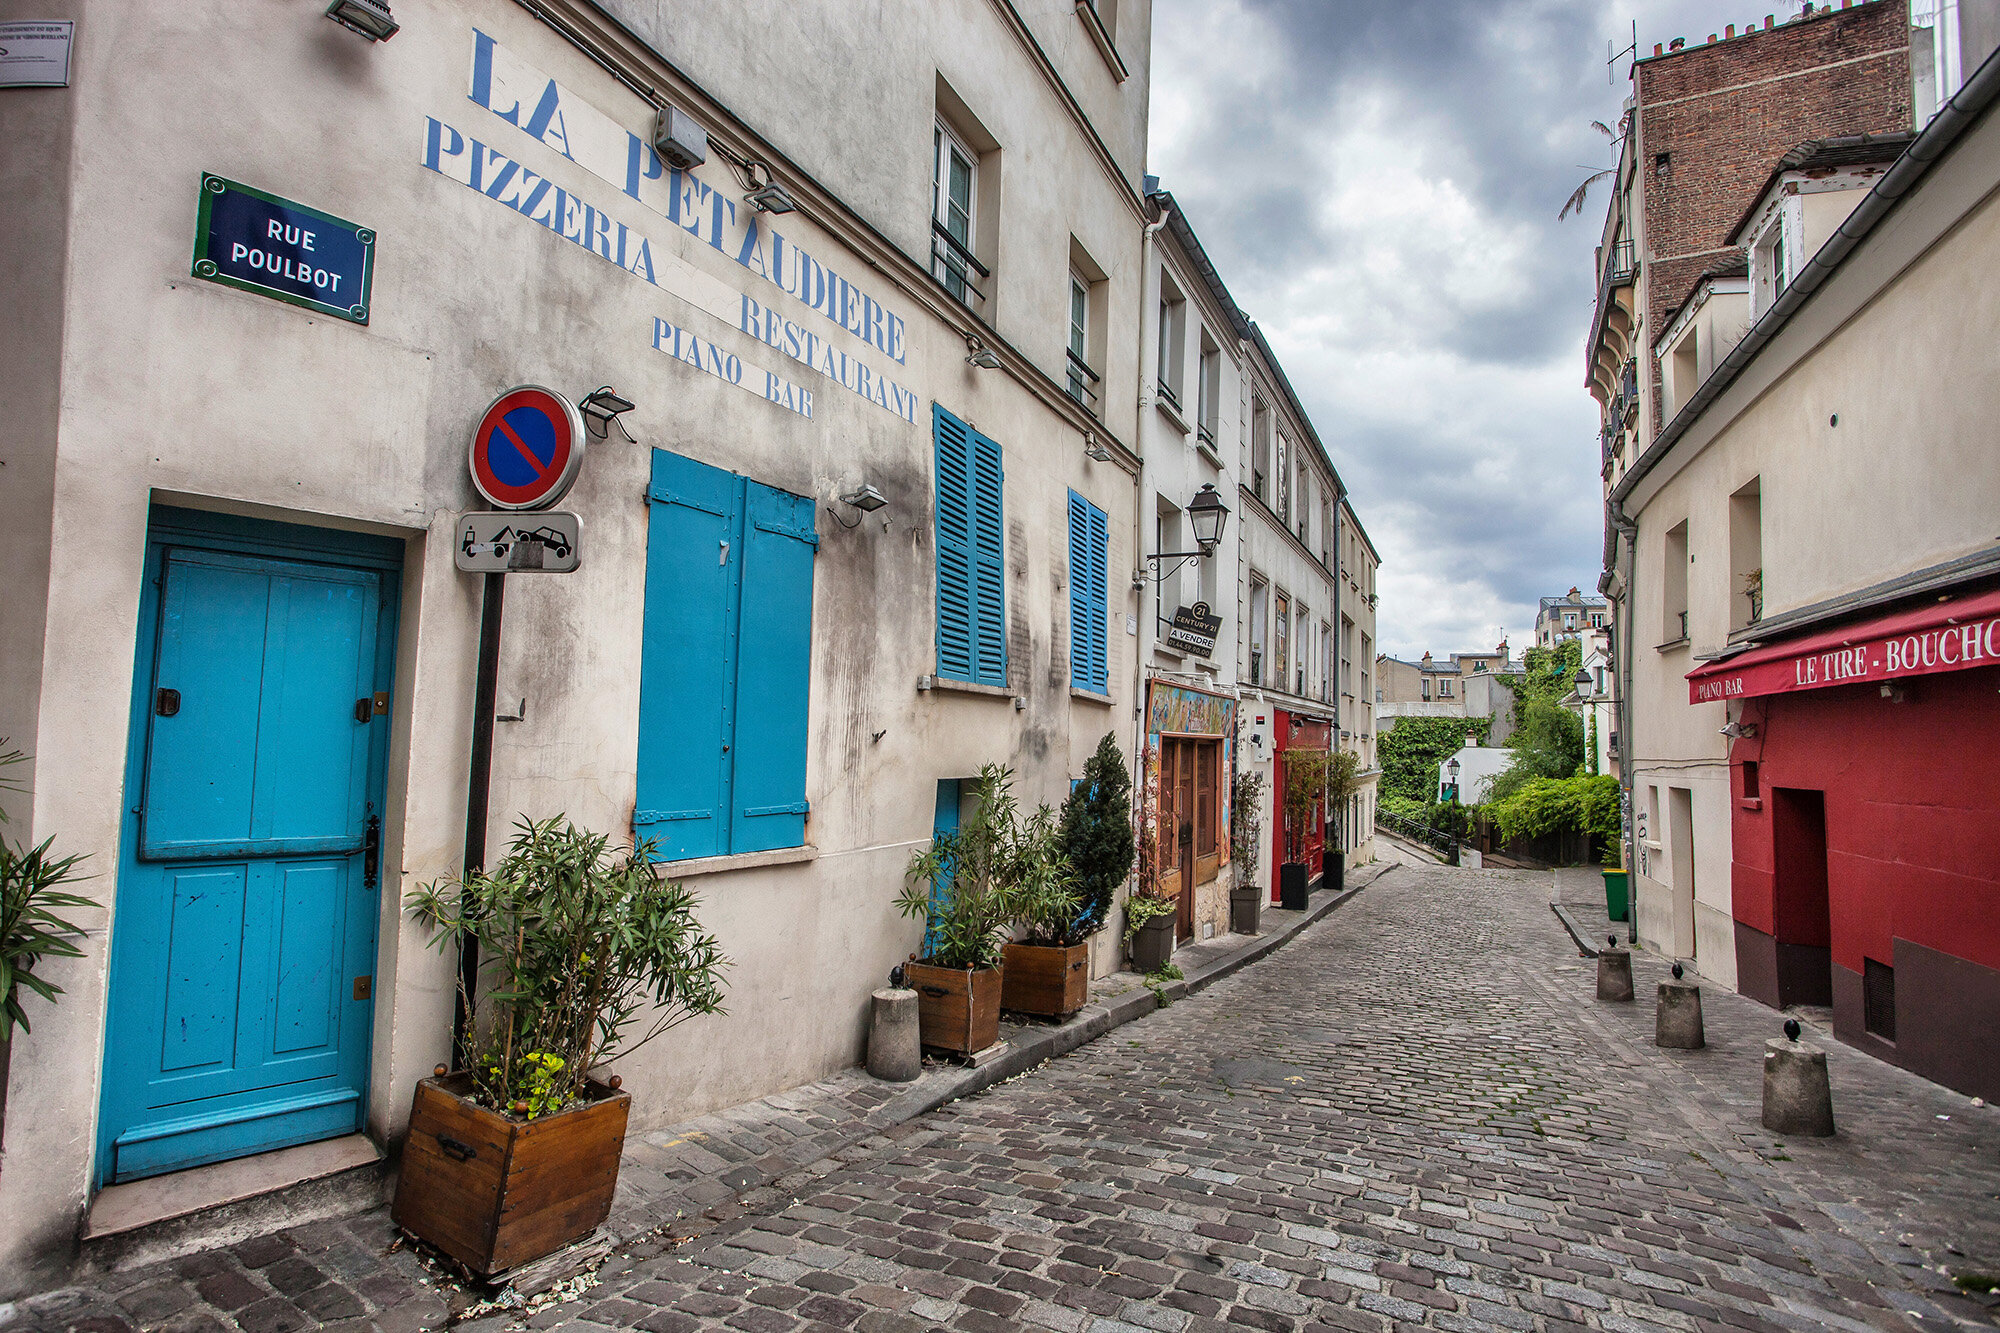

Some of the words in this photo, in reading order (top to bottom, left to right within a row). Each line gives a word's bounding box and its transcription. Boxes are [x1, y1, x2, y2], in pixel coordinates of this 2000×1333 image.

[467, 27, 575, 162] LA
[622, 130, 906, 366] PETAUDIERE
[267, 218, 316, 252] RUE
[231, 242, 342, 293] POULBOT
[423, 115, 659, 287] PIZZERIA
[740, 293, 918, 425] RESTAURANT
[652, 316, 742, 385] PIANO
[765, 371, 813, 420] BAR
[1176, 615, 1209, 629] CENTURY
[1180, 631, 1214, 648] VENDRE
[1796, 656, 1817, 686] LE
[1821, 647, 1867, 682] TIRE
[1699, 681, 1722, 700] PIANO
[1725, 677, 1744, 696] BAR
